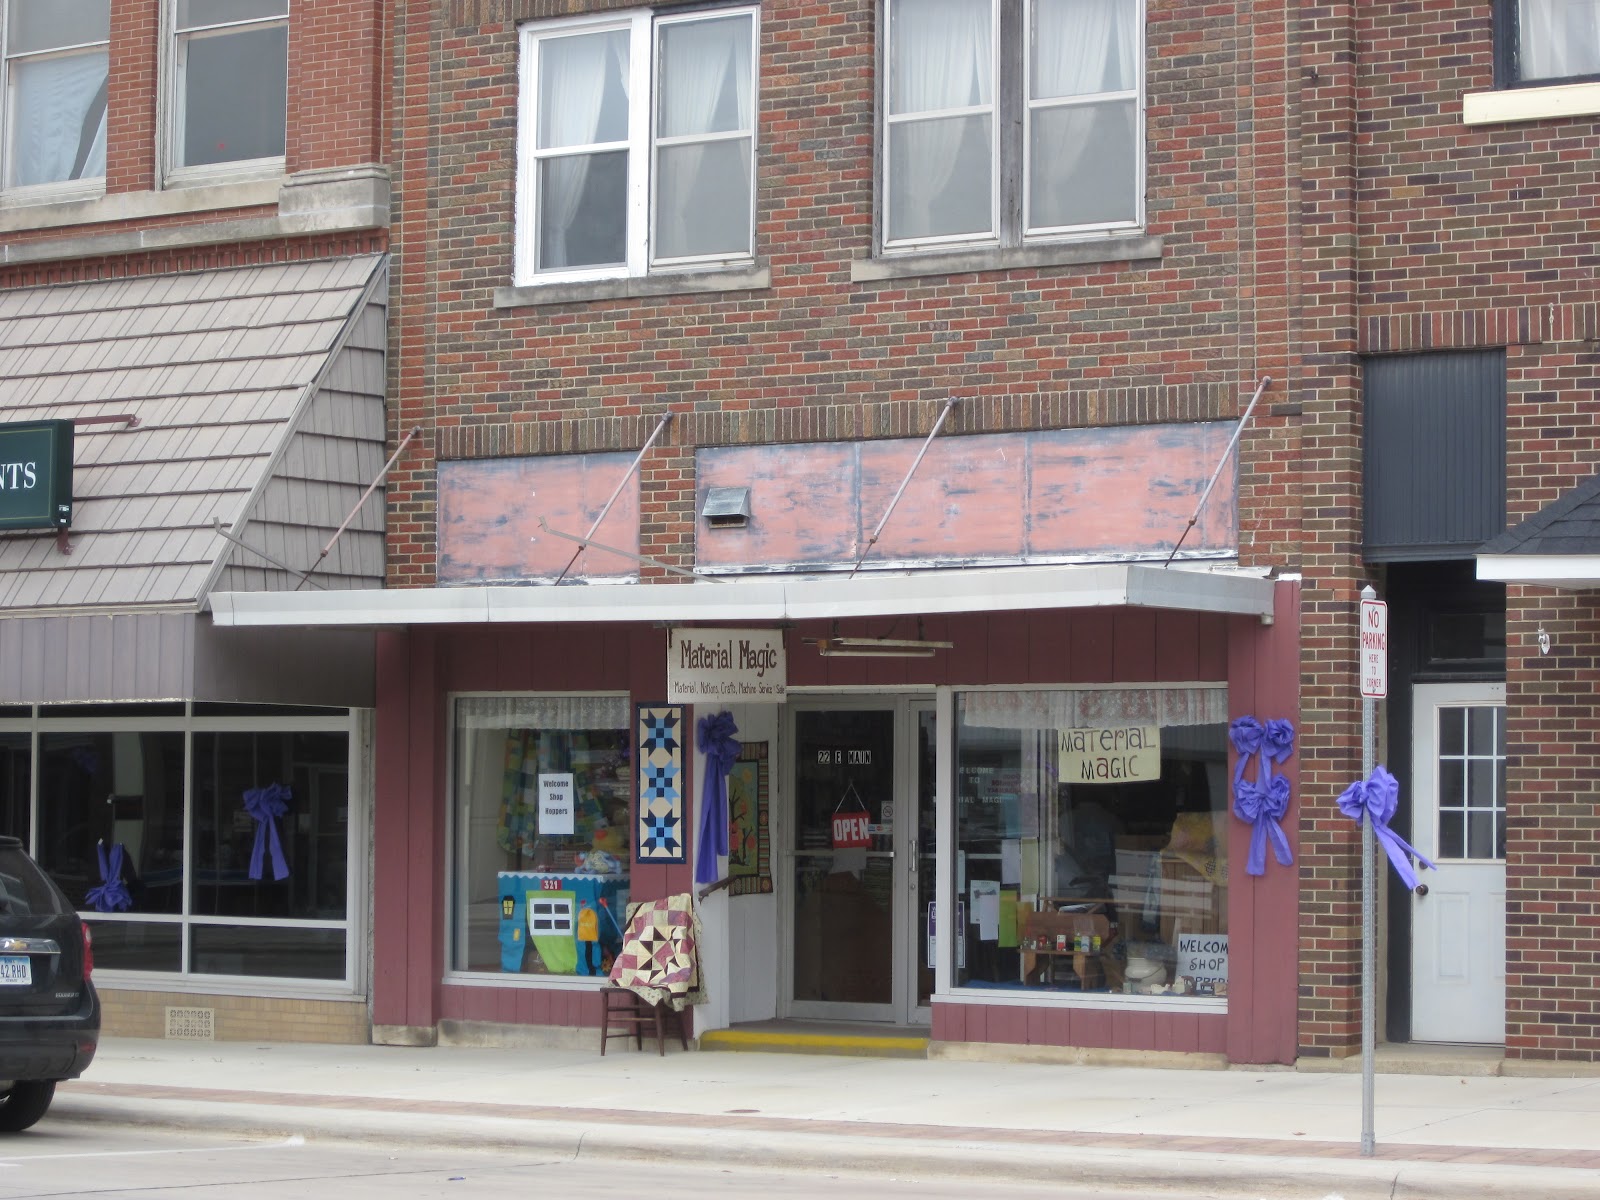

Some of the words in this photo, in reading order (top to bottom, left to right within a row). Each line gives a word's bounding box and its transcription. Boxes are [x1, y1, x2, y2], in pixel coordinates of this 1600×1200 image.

[1368, 610, 1379, 628] NO
[1362, 632, 1385, 651] PARKING
[680, 639, 732, 669] Material
[739, 639, 777, 677] Magic
[1368, 654, 1379, 664] HERE
[1370, 666, 1377, 676] TO
[1366, 678, 1381, 688] CORNER
[817, 750, 831, 764] 22
[834, 750, 842, 764] E
[848, 750, 871, 764] MAIN
[543, 780, 569, 788] Welcome
[549, 793, 564, 801] Shop
[545, 807, 568, 816] Hoppers
[833, 817, 870, 841] OPEN
[543, 880, 558, 890] 321
[1180, 940, 1228, 954] WELCOM
[1189, 957, 1225, 971] SHOP
